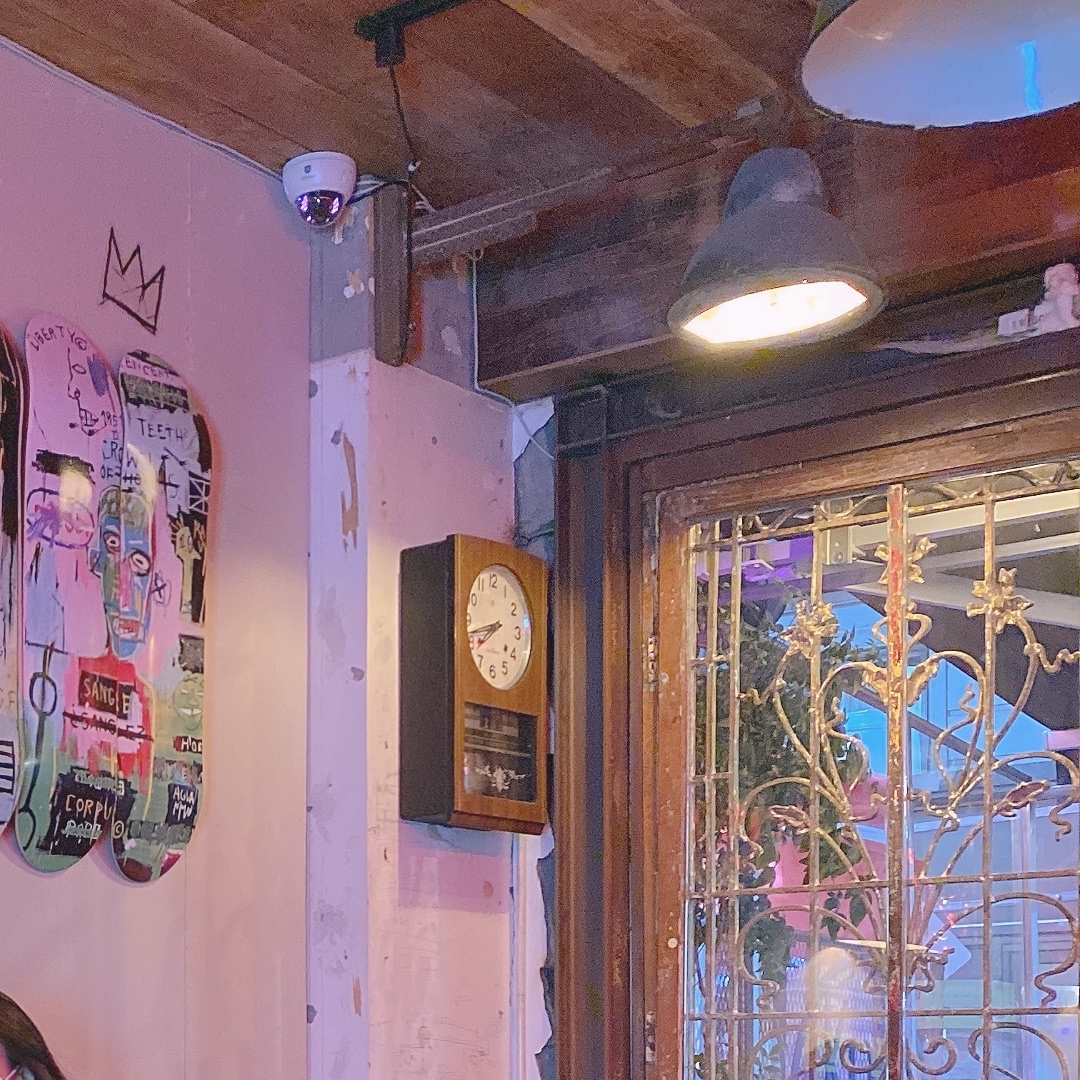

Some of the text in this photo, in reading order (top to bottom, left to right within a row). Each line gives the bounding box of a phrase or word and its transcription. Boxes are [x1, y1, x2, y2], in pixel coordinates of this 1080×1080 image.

[489, 573, 498, 589] 12
[510, 602, 518, 617] 2
[514, 625, 522, 641] 3
[477, 654, 484, 669] 7
[510, 647, 517, 661] 4
[489, 660, 509, 679] 6 5
